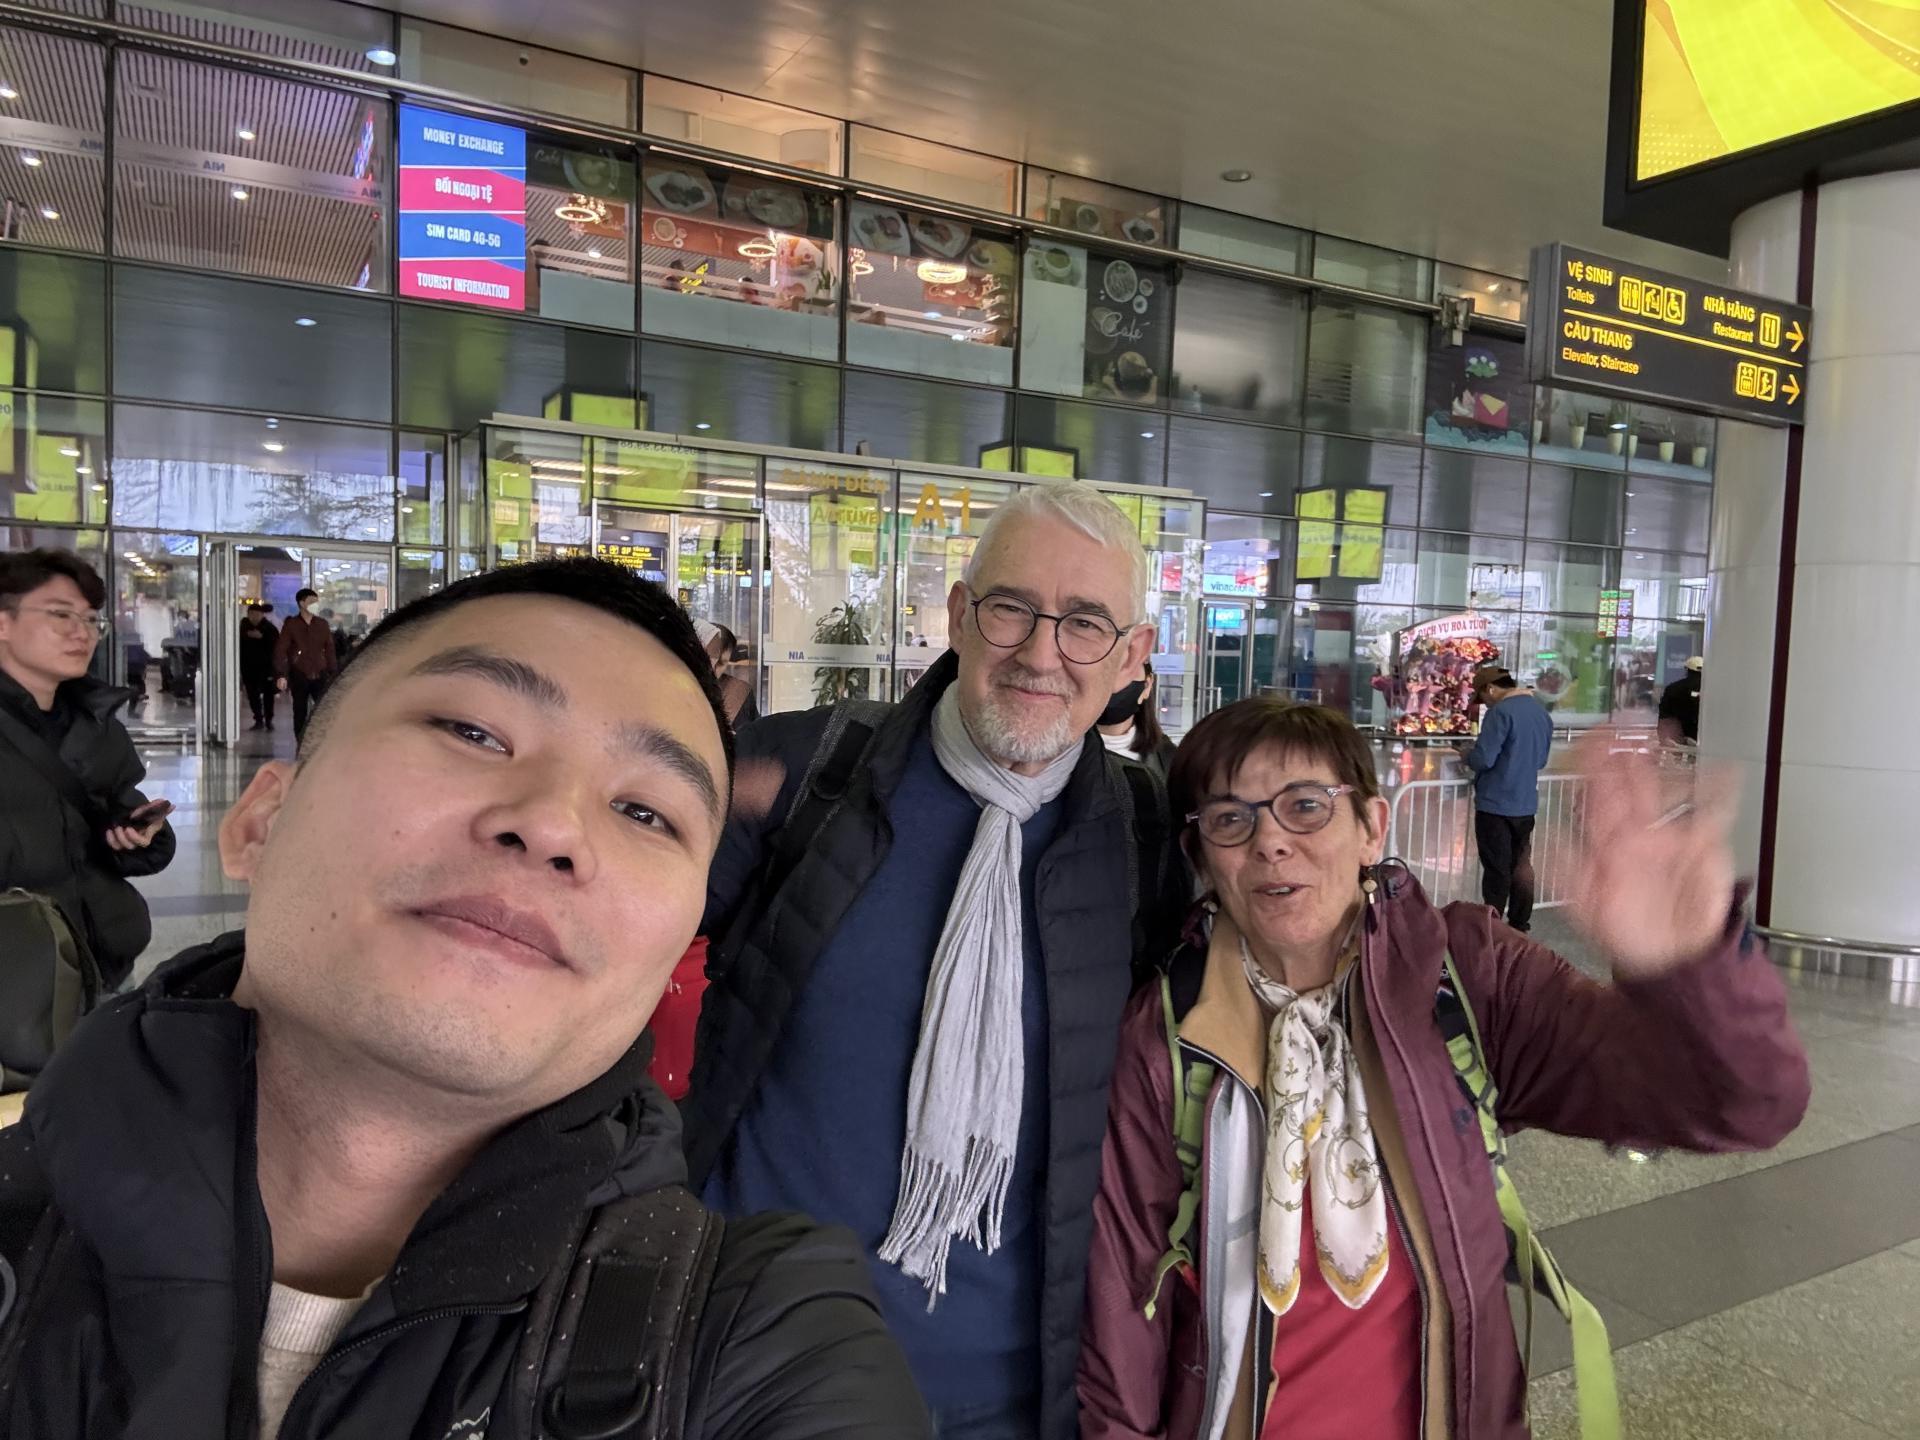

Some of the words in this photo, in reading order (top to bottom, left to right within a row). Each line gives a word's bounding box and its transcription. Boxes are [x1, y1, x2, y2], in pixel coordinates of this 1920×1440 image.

[423, 127, 456, 147] MONEY
[458, 133, 504, 155] EXCHANGE
[426, 223, 445, 239] SIM
[447, 226, 471, 243] CARD
[473, 230, 501, 248] 4G-5G
[417, 272, 452, 292] TOURIST
[453, 278, 510, 300] INFORMATION
[1567, 261, 1584, 282] VỆ
[1585, 265, 1613, 286] SINH
[1566, 286, 1595, 305] Toilets
[1703, 295, 1727, 315] NHÀ
[1727, 301, 1756, 323] HÀNG
[1591, 327, 1633, 351] THANG
[1713, 322, 1754, 343] Restaurant
[1562, 347, 1599, 368] Elevator,
[1600, 355, 1640, 375] Staircase
[912, 482, 972, 531] A1
[788, 651, 804, 660] NIA
[876, 654, 891, 663] NIA
